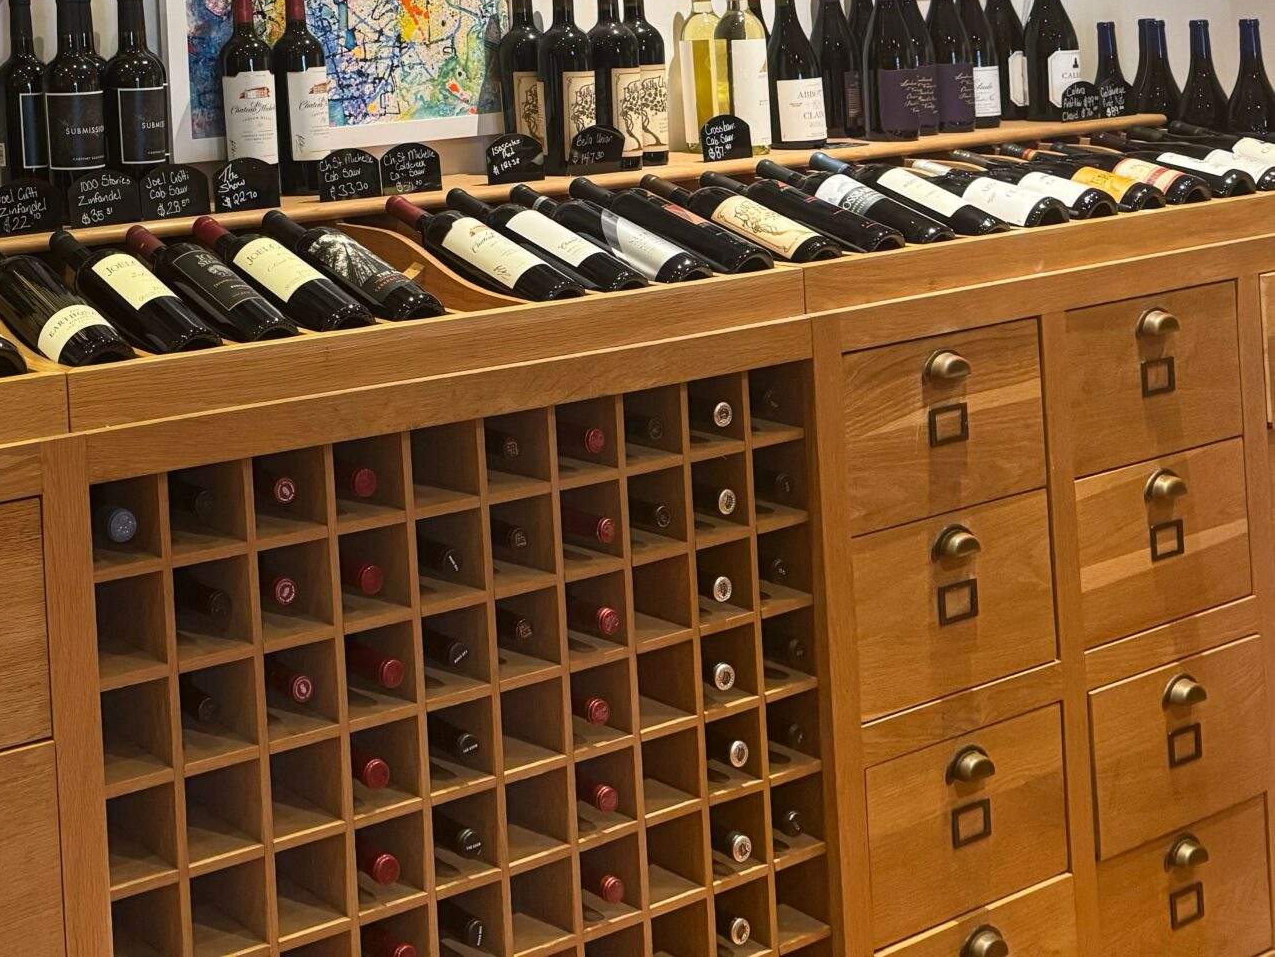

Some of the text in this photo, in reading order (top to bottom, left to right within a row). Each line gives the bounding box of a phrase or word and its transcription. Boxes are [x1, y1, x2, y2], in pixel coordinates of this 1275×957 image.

[408, 148, 436, 161] Michelle
[145, 171, 167, 189] Joel
[218, 163, 239, 183] The
[80, 174, 131, 193] 1000 Stories
[217, 179, 246, 193] Show
[78, 189, 122, 207] Zinfandel
